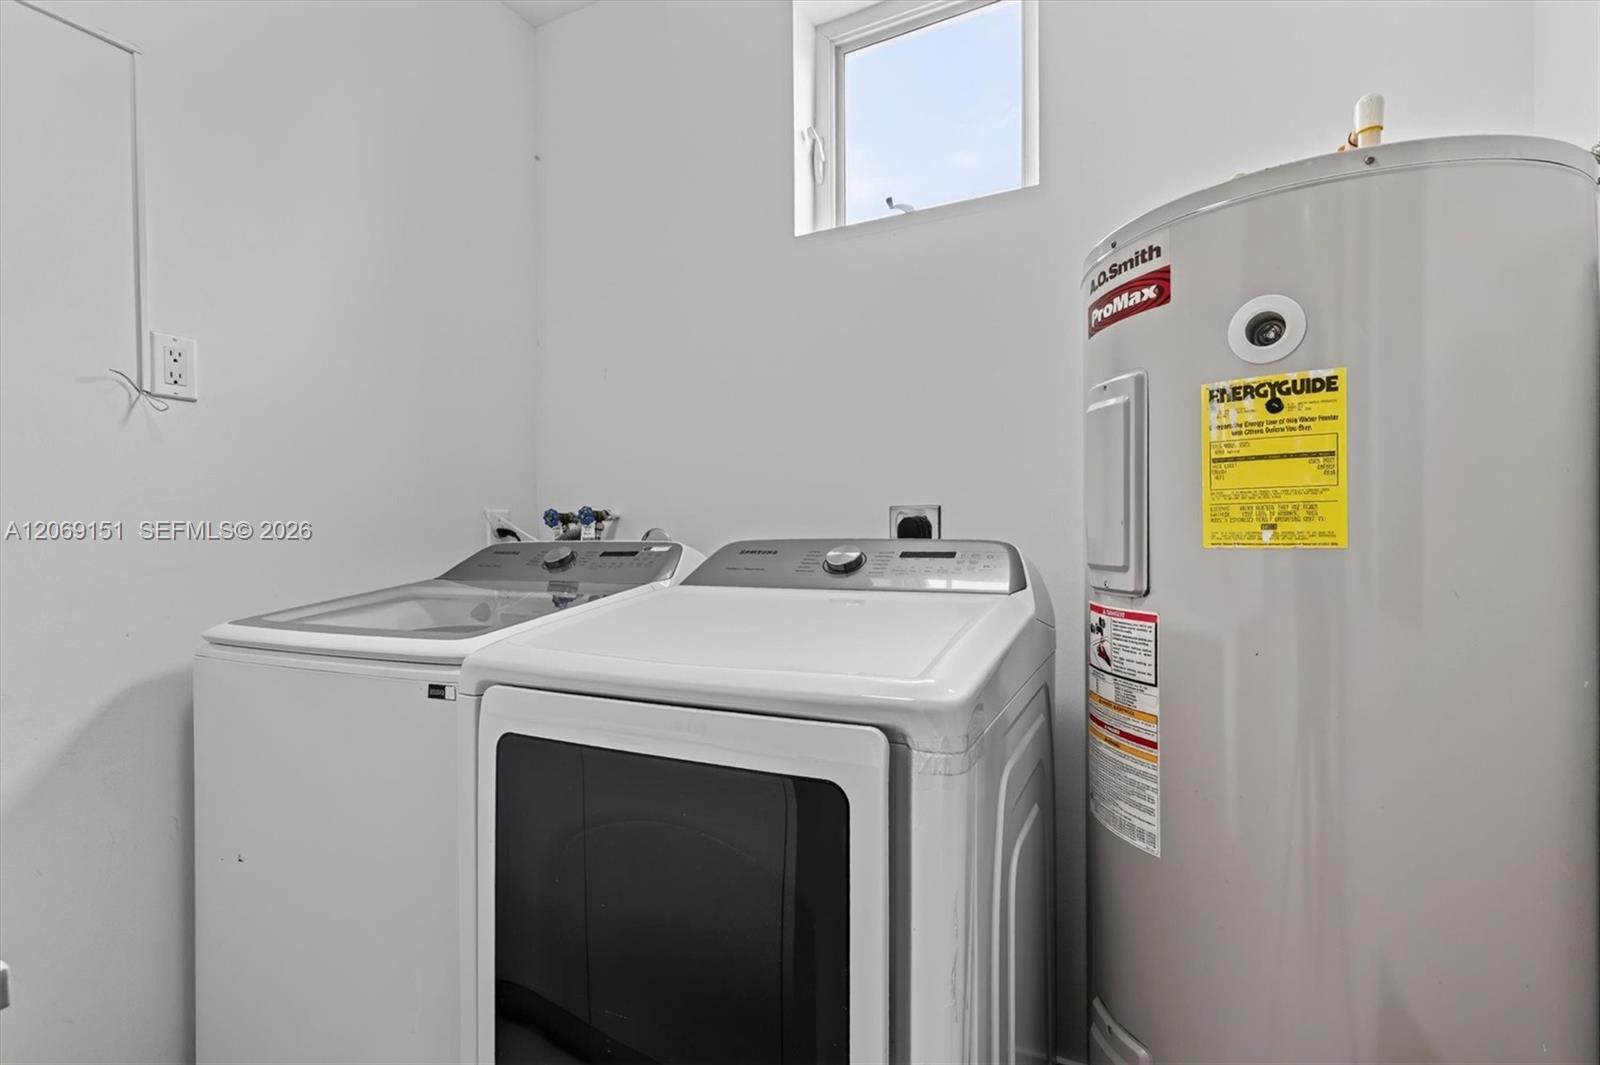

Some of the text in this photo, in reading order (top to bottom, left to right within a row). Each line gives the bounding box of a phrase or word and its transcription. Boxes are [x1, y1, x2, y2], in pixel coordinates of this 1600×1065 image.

[1090, 244, 1162, 296] A.O.Smith
[1091, 284, 1158, 327] ProMax
[1208, 375, 1339, 403] ENERGYGUIDE
